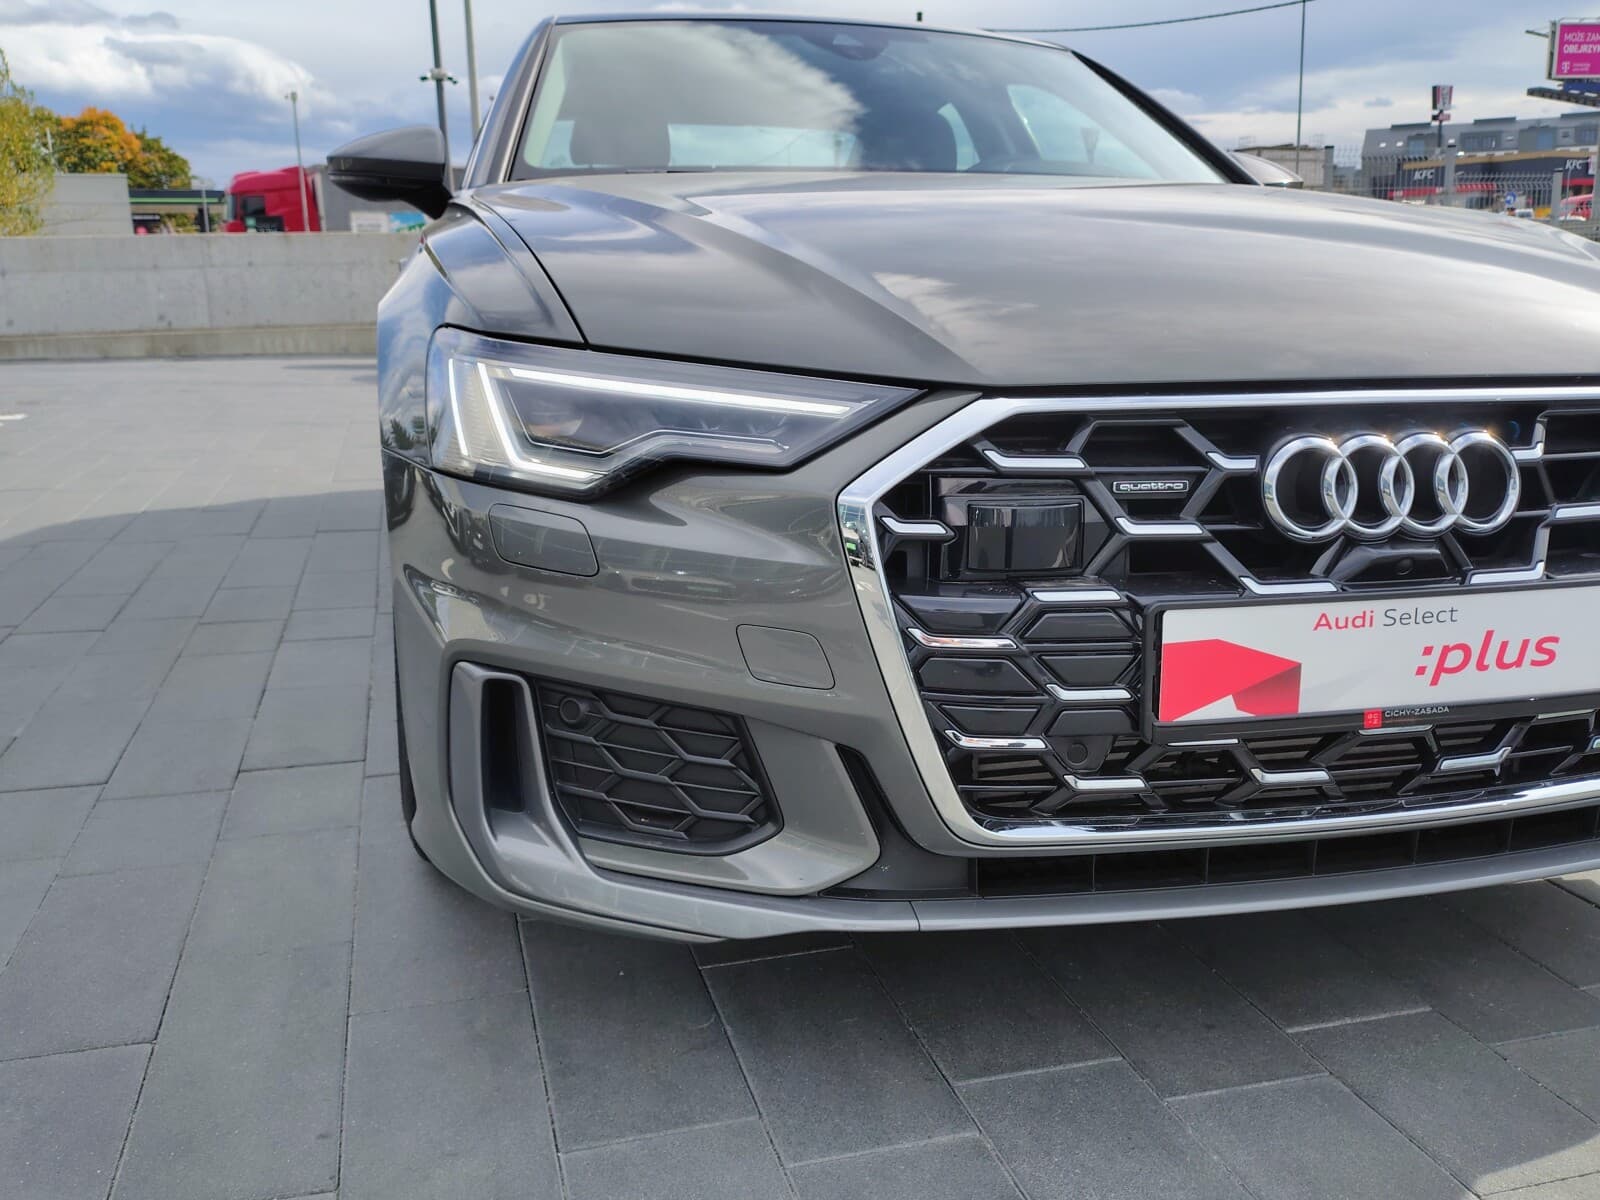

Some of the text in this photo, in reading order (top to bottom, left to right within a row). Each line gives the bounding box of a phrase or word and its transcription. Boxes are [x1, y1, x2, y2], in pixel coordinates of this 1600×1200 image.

[1565, 159, 1582, 170] KFC
[1414, 169, 1435, 180] KFC
[1119, 482, 1184, 492] quattro
[1312, 606, 1458, 632] Audi Select
[1384, 706, 1451, 718] CICHY-ZASADA
